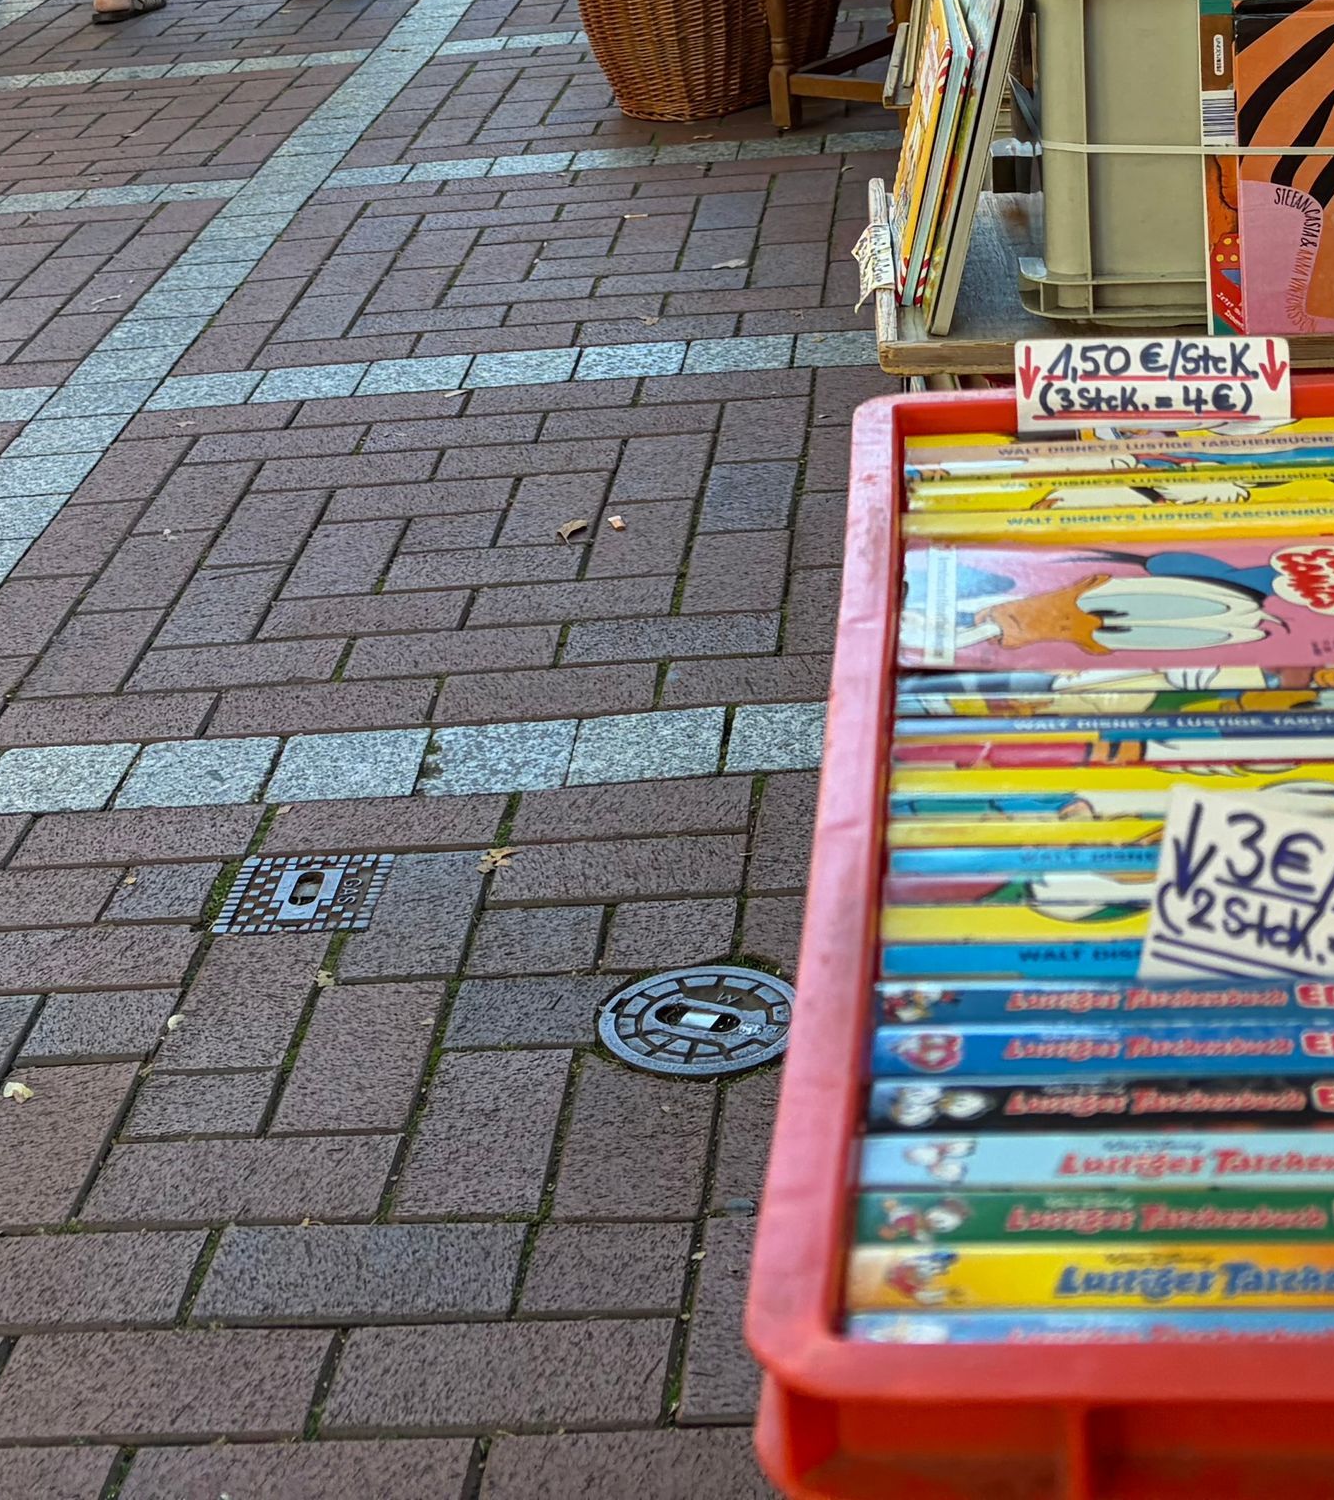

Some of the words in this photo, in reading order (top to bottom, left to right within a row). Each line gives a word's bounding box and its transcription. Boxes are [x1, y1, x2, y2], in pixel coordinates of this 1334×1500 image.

[1047, 342, 1131, 382] 1,50
[337, 878, 362, 904] GAS
[1058, 1153, 1203, 1178] Lustiger
[1055, 1266, 1216, 1302] Lustiger
